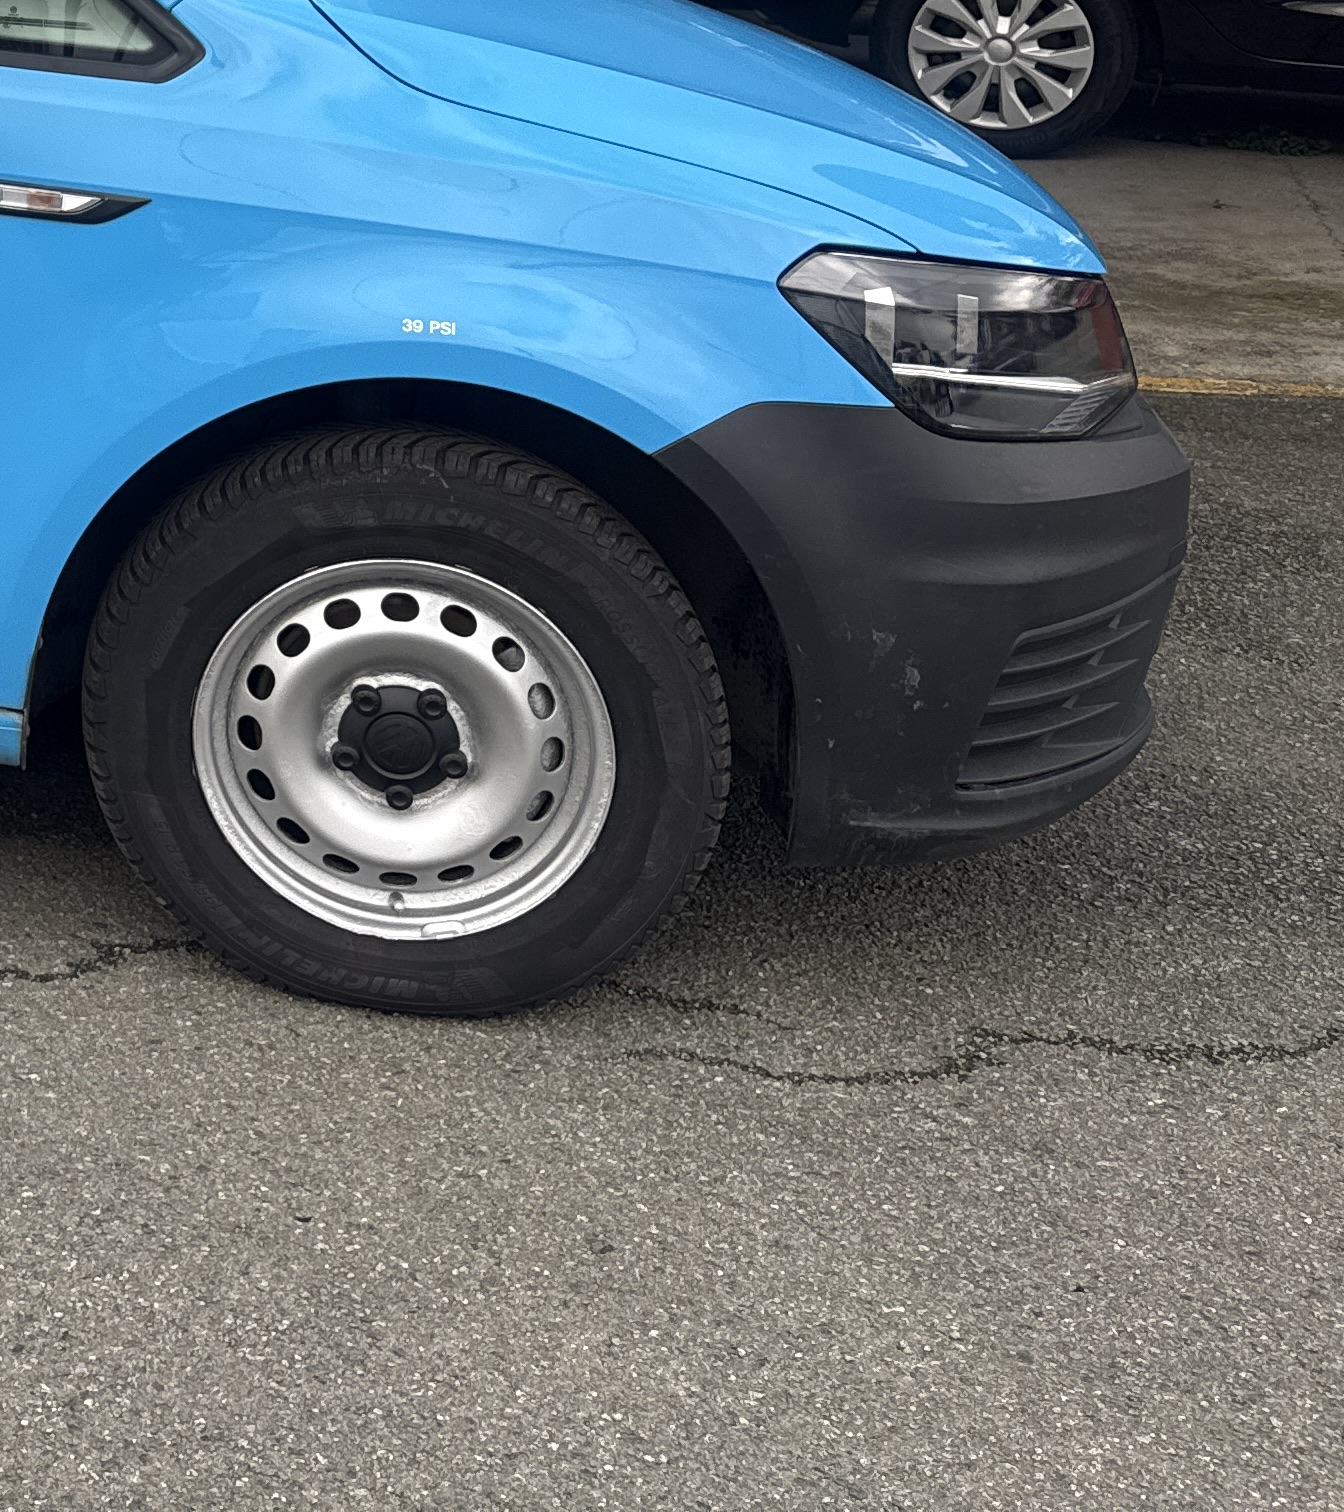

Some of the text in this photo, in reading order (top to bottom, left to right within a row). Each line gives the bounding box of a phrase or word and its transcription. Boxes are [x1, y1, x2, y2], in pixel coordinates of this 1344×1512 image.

[401, 318, 456, 336] 39 PSI
[385, 500, 569, 570] MICHELIN
[235, 924, 420, 999] MICHELIN
